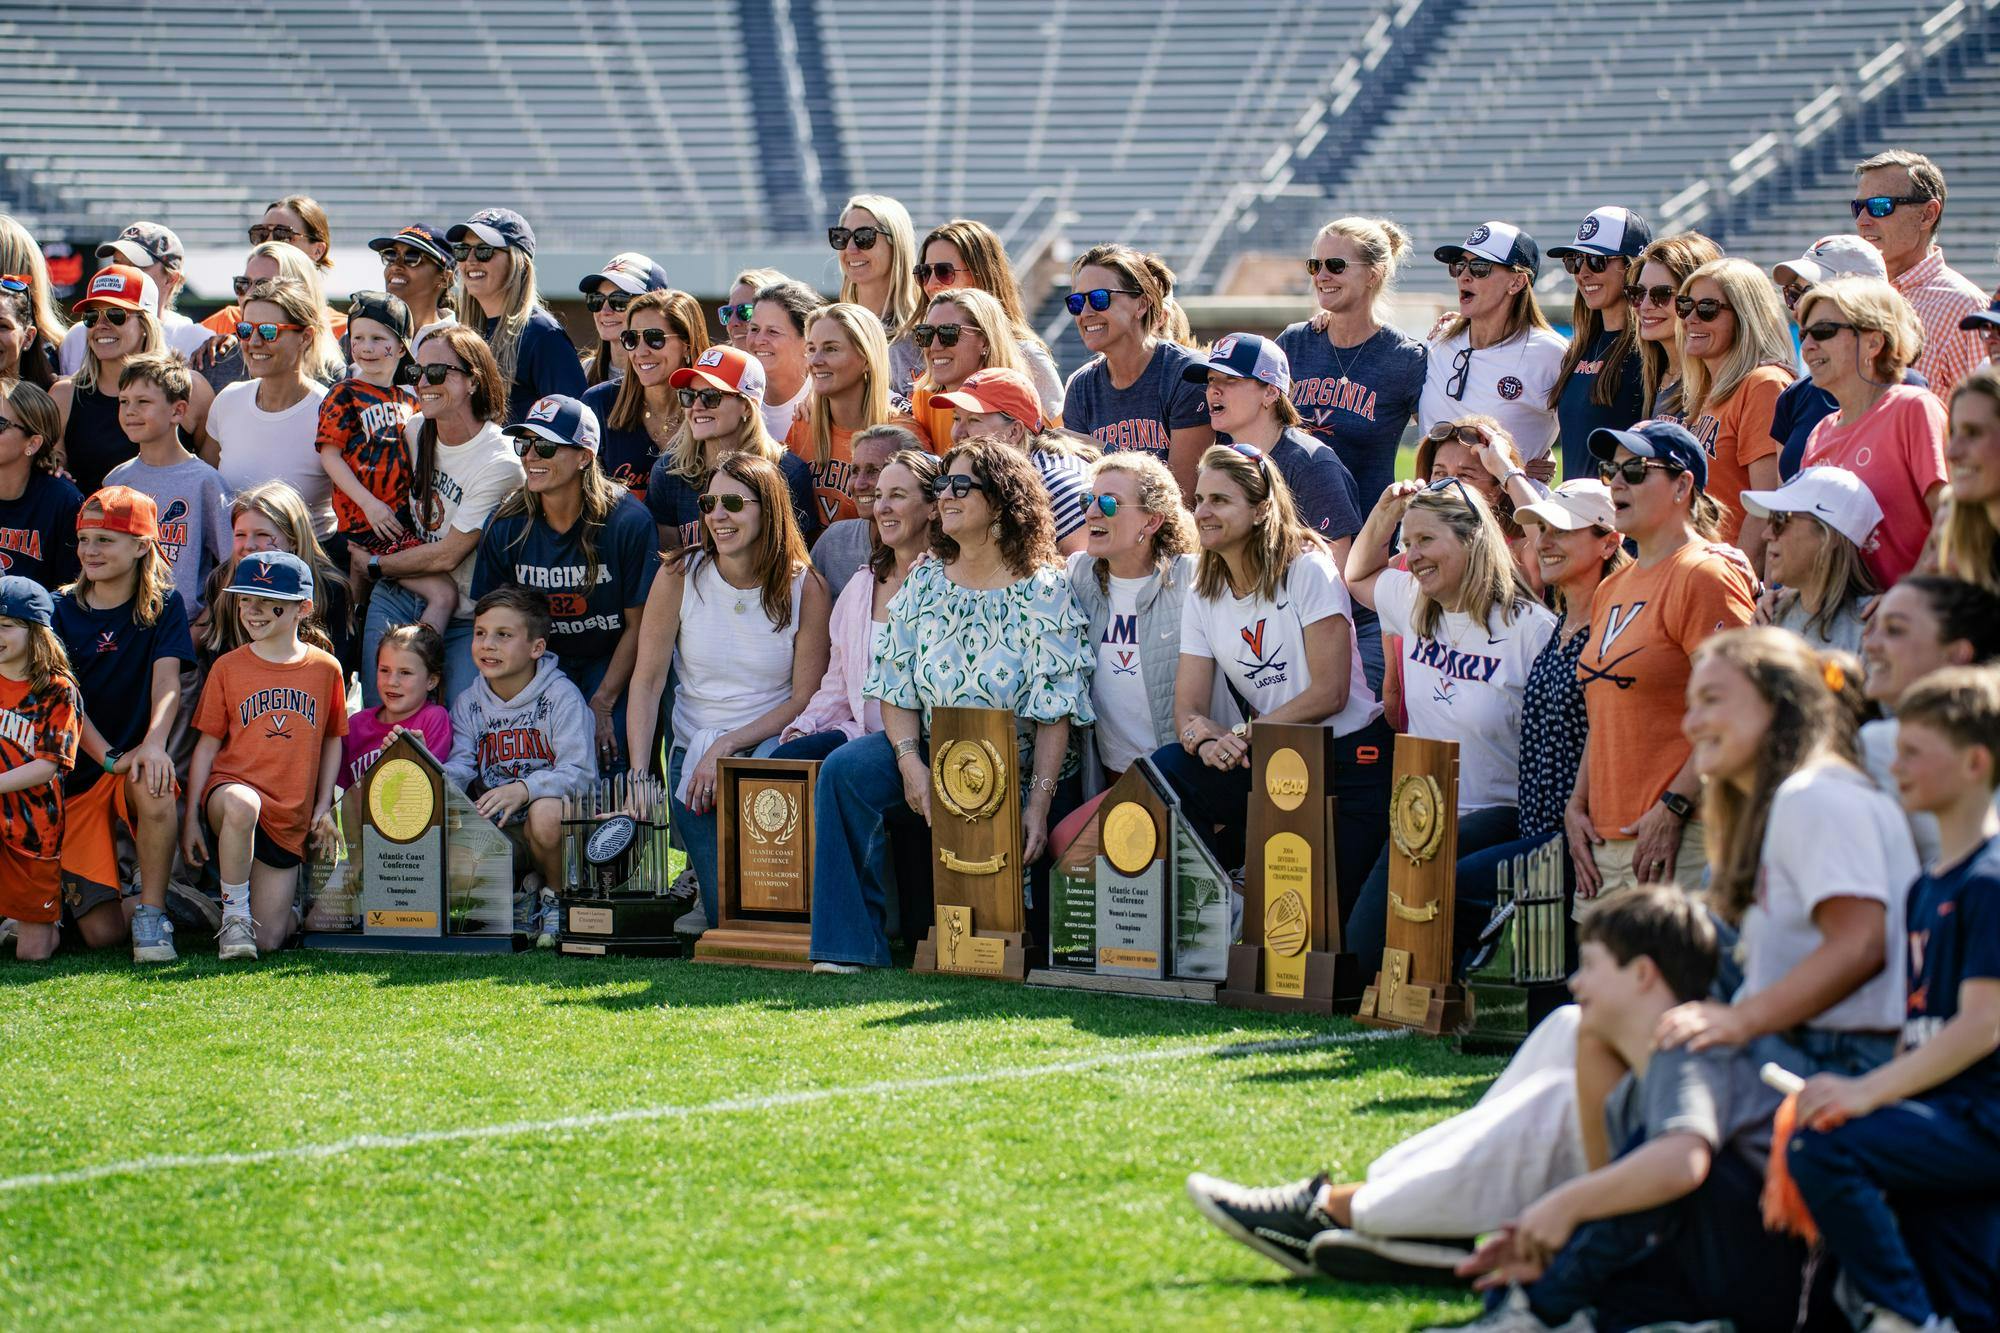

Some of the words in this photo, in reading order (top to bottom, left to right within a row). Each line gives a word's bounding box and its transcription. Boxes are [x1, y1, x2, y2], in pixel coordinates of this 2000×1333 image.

[1582, 224, 1592, 233] 50
[1503, 382, 1517, 394] 50
[515, 564, 612, 588] VIRGINA
[553, 596, 577, 614] 32
[1240, 617, 1267, 662] V
[1117, 650, 1135, 668] V
[239, 687, 317, 729] VIRGINIA
[270, 714, 288, 732] V
[1270, 779, 1307, 796] NCAA
[378, 852, 404, 861] Atlantic
[405, 853, 425, 861] Coast
[748, 848, 774, 856] ATLANTIC
[775, 849, 794, 857] COAST
[382, 861, 420, 869] Conference
[752, 857, 789, 865] CONFERENCE
[770, 871, 800, 879] LACROSSE
[754, 880, 790, 888] CHAMPIONS
[386, 886, 417, 895] Champions
[1108, 886, 1130, 895] Atlantic
[1131, 887, 1149, 896] Coast
[1111, 895, 1145, 905] Conference
[1108, 908, 1128, 917] Women's
[1115, 923, 1141, 932] Champions
